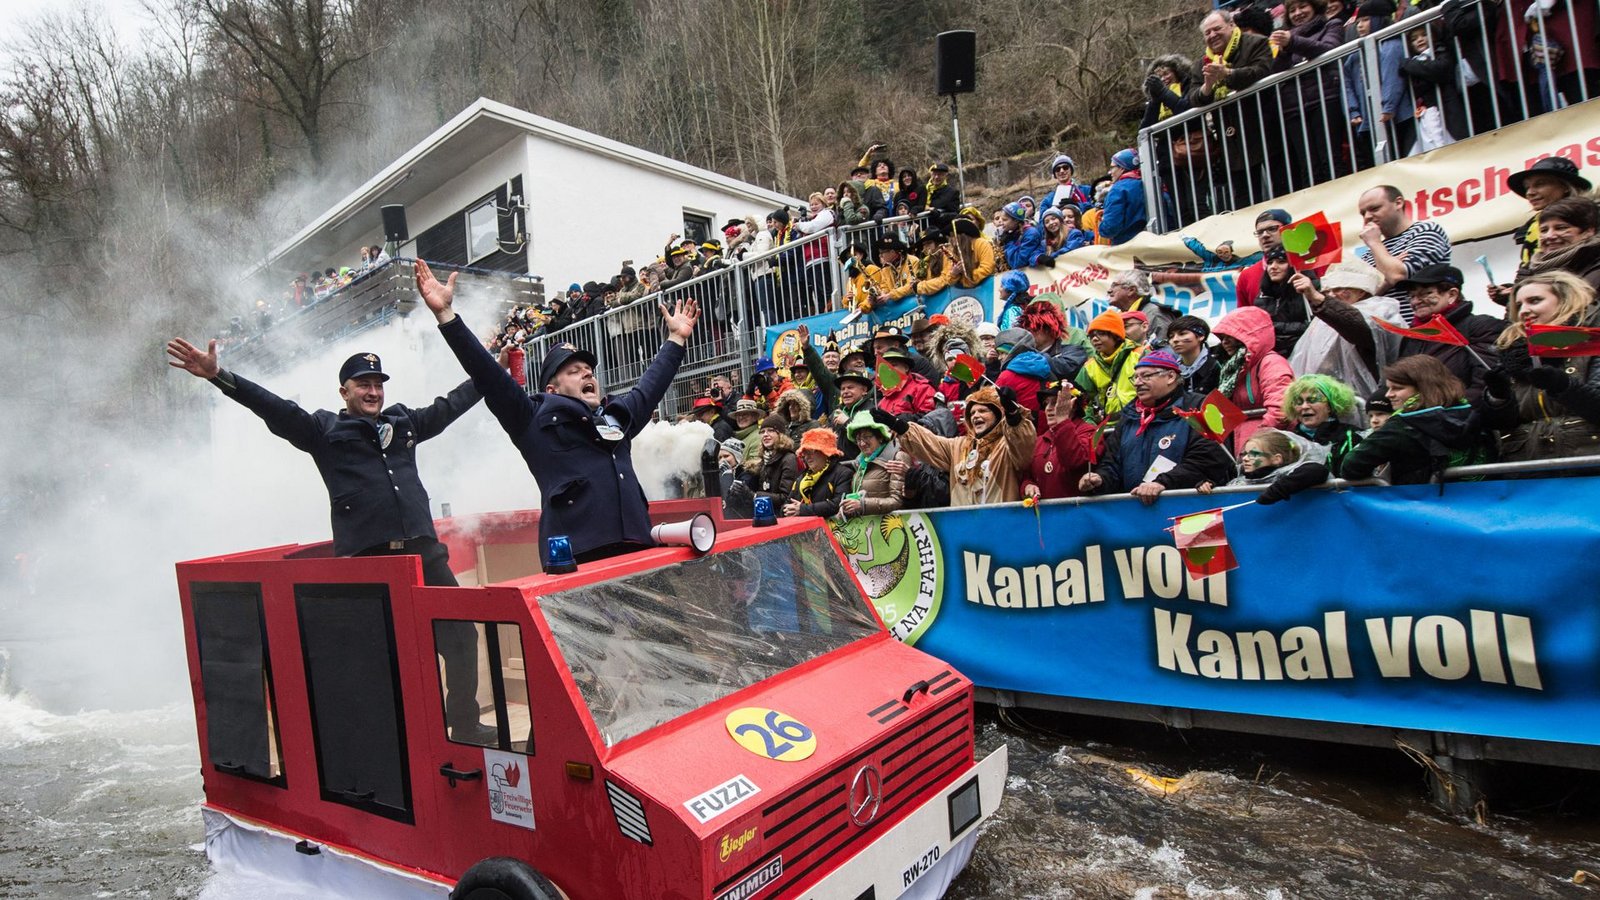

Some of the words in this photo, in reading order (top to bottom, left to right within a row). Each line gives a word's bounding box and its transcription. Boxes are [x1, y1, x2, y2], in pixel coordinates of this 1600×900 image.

[909, 522, 935, 598] FAHRT
[963, 545, 1105, 609] Kanal
[901, 604, 928, 633] NA
[1154, 607, 1355, 681] Kanal
[1365, 609, 1543, 692] voll
[735, 710, 813, 759] 26
[690, 778, 756, 819] FUZZI
[720, 826, 757, 863] Ziegler
[722, 861, 780, 900] NIMOG
[903, 845, 940, 888] RW-270
